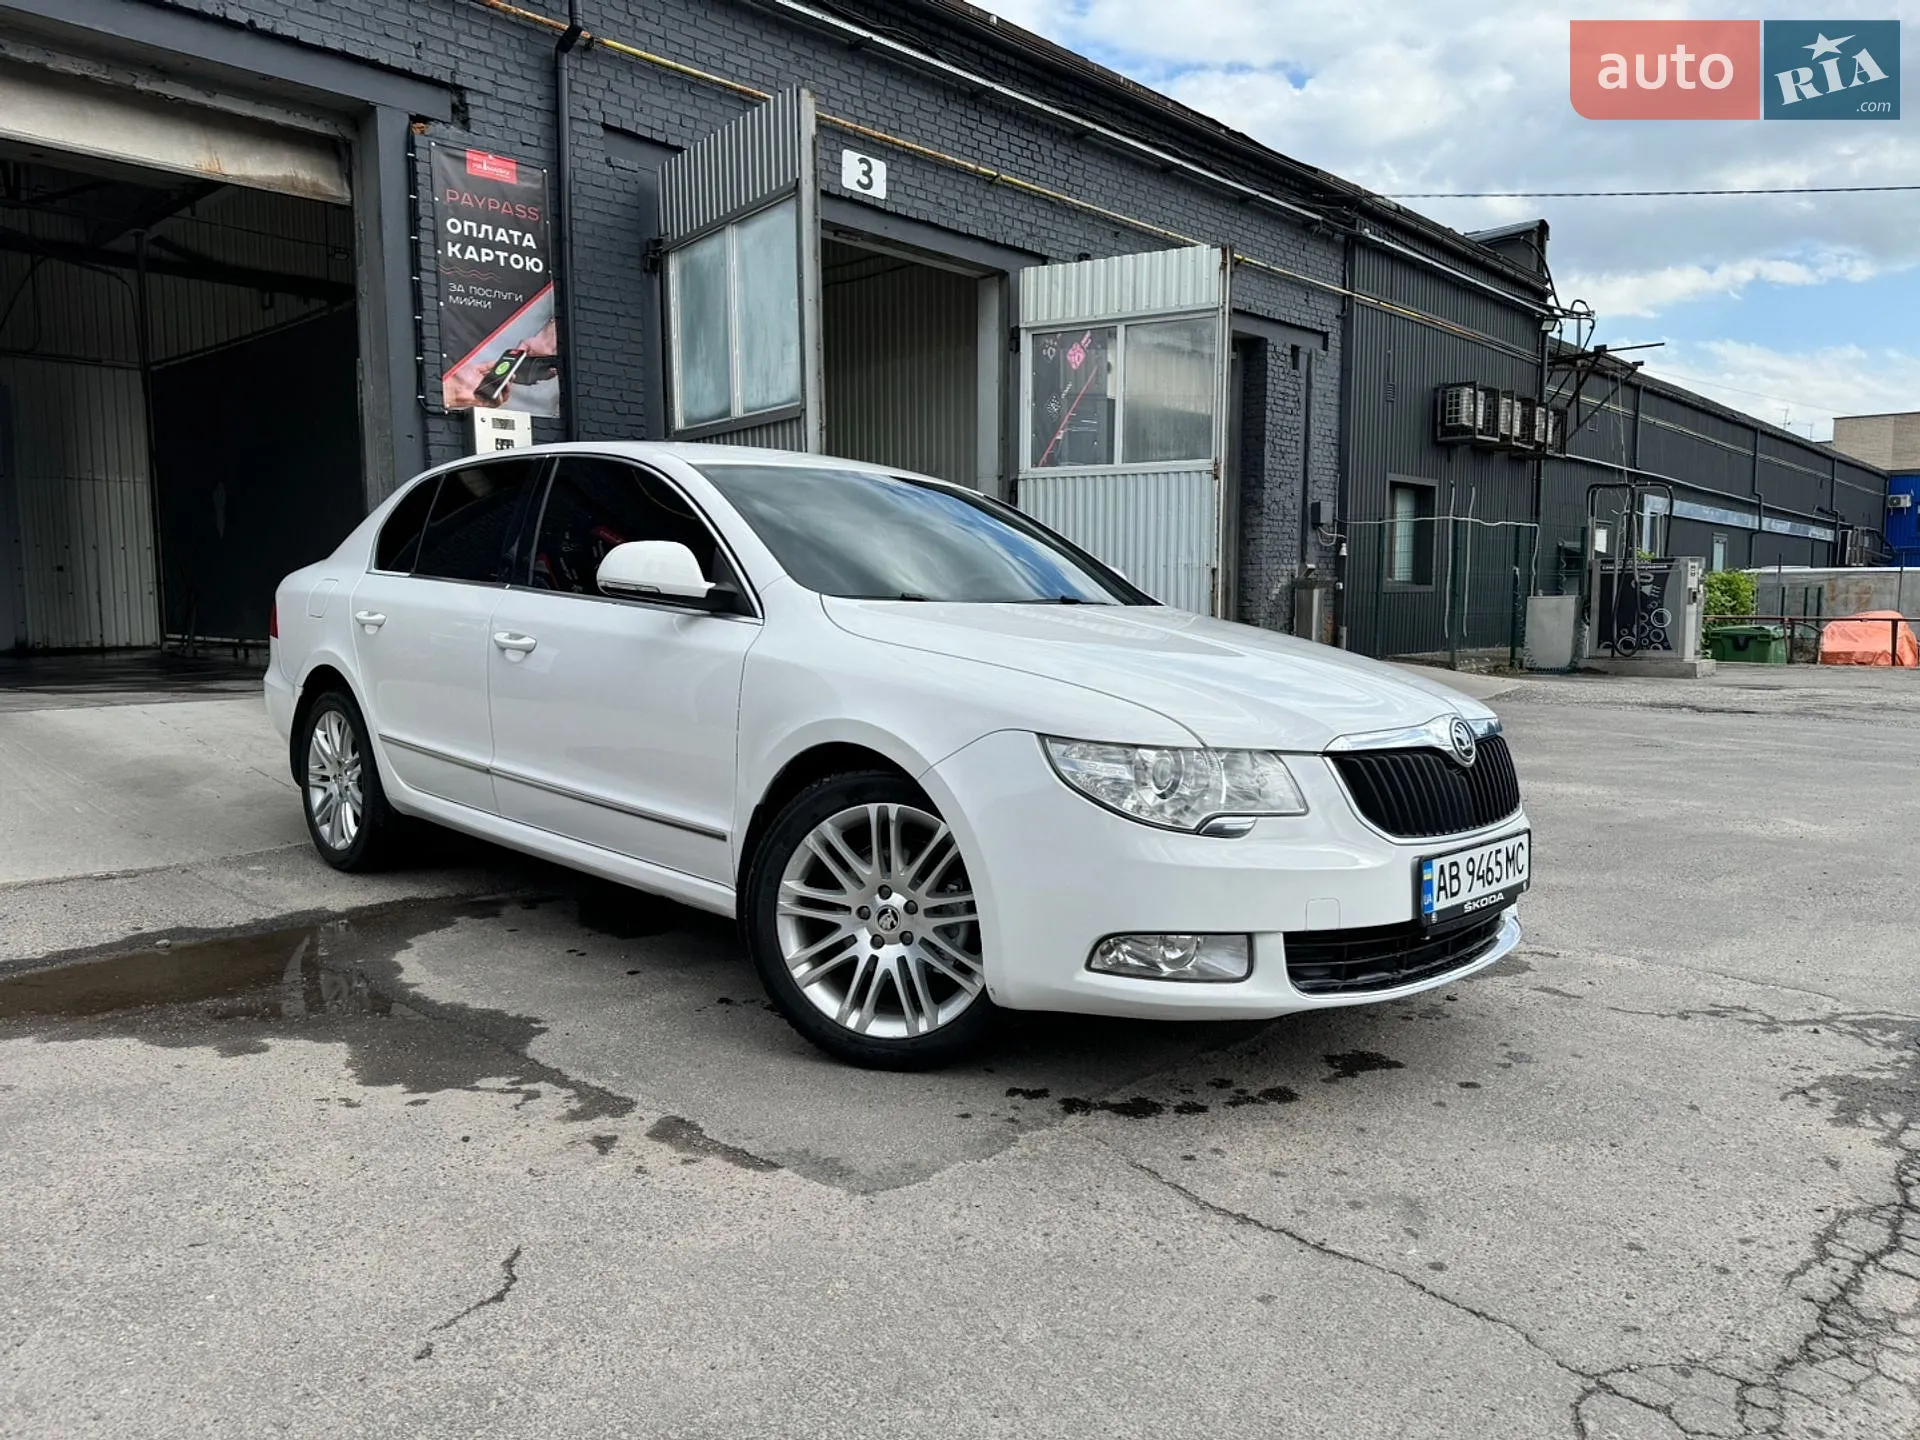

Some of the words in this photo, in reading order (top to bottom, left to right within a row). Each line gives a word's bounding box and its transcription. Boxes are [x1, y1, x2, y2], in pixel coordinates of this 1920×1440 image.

[856, 157, 874, 191] 3
[446, 189, 539, 221] PAYPASS
[446, 218, 537, 249] ОПЛАТА
[447, 241, 544, 273] КАРТОЮ
[448, 283, 465, 293] ЗА
[469, 285, 524, 302] ПОСЛУГИ
[448, 295, 492, 309] МИЙКИ
[1436, 861, 1461, 903] AB
[1466, 848, 1503, 893] 9465
[1505, 842, 1525, 880] MC
